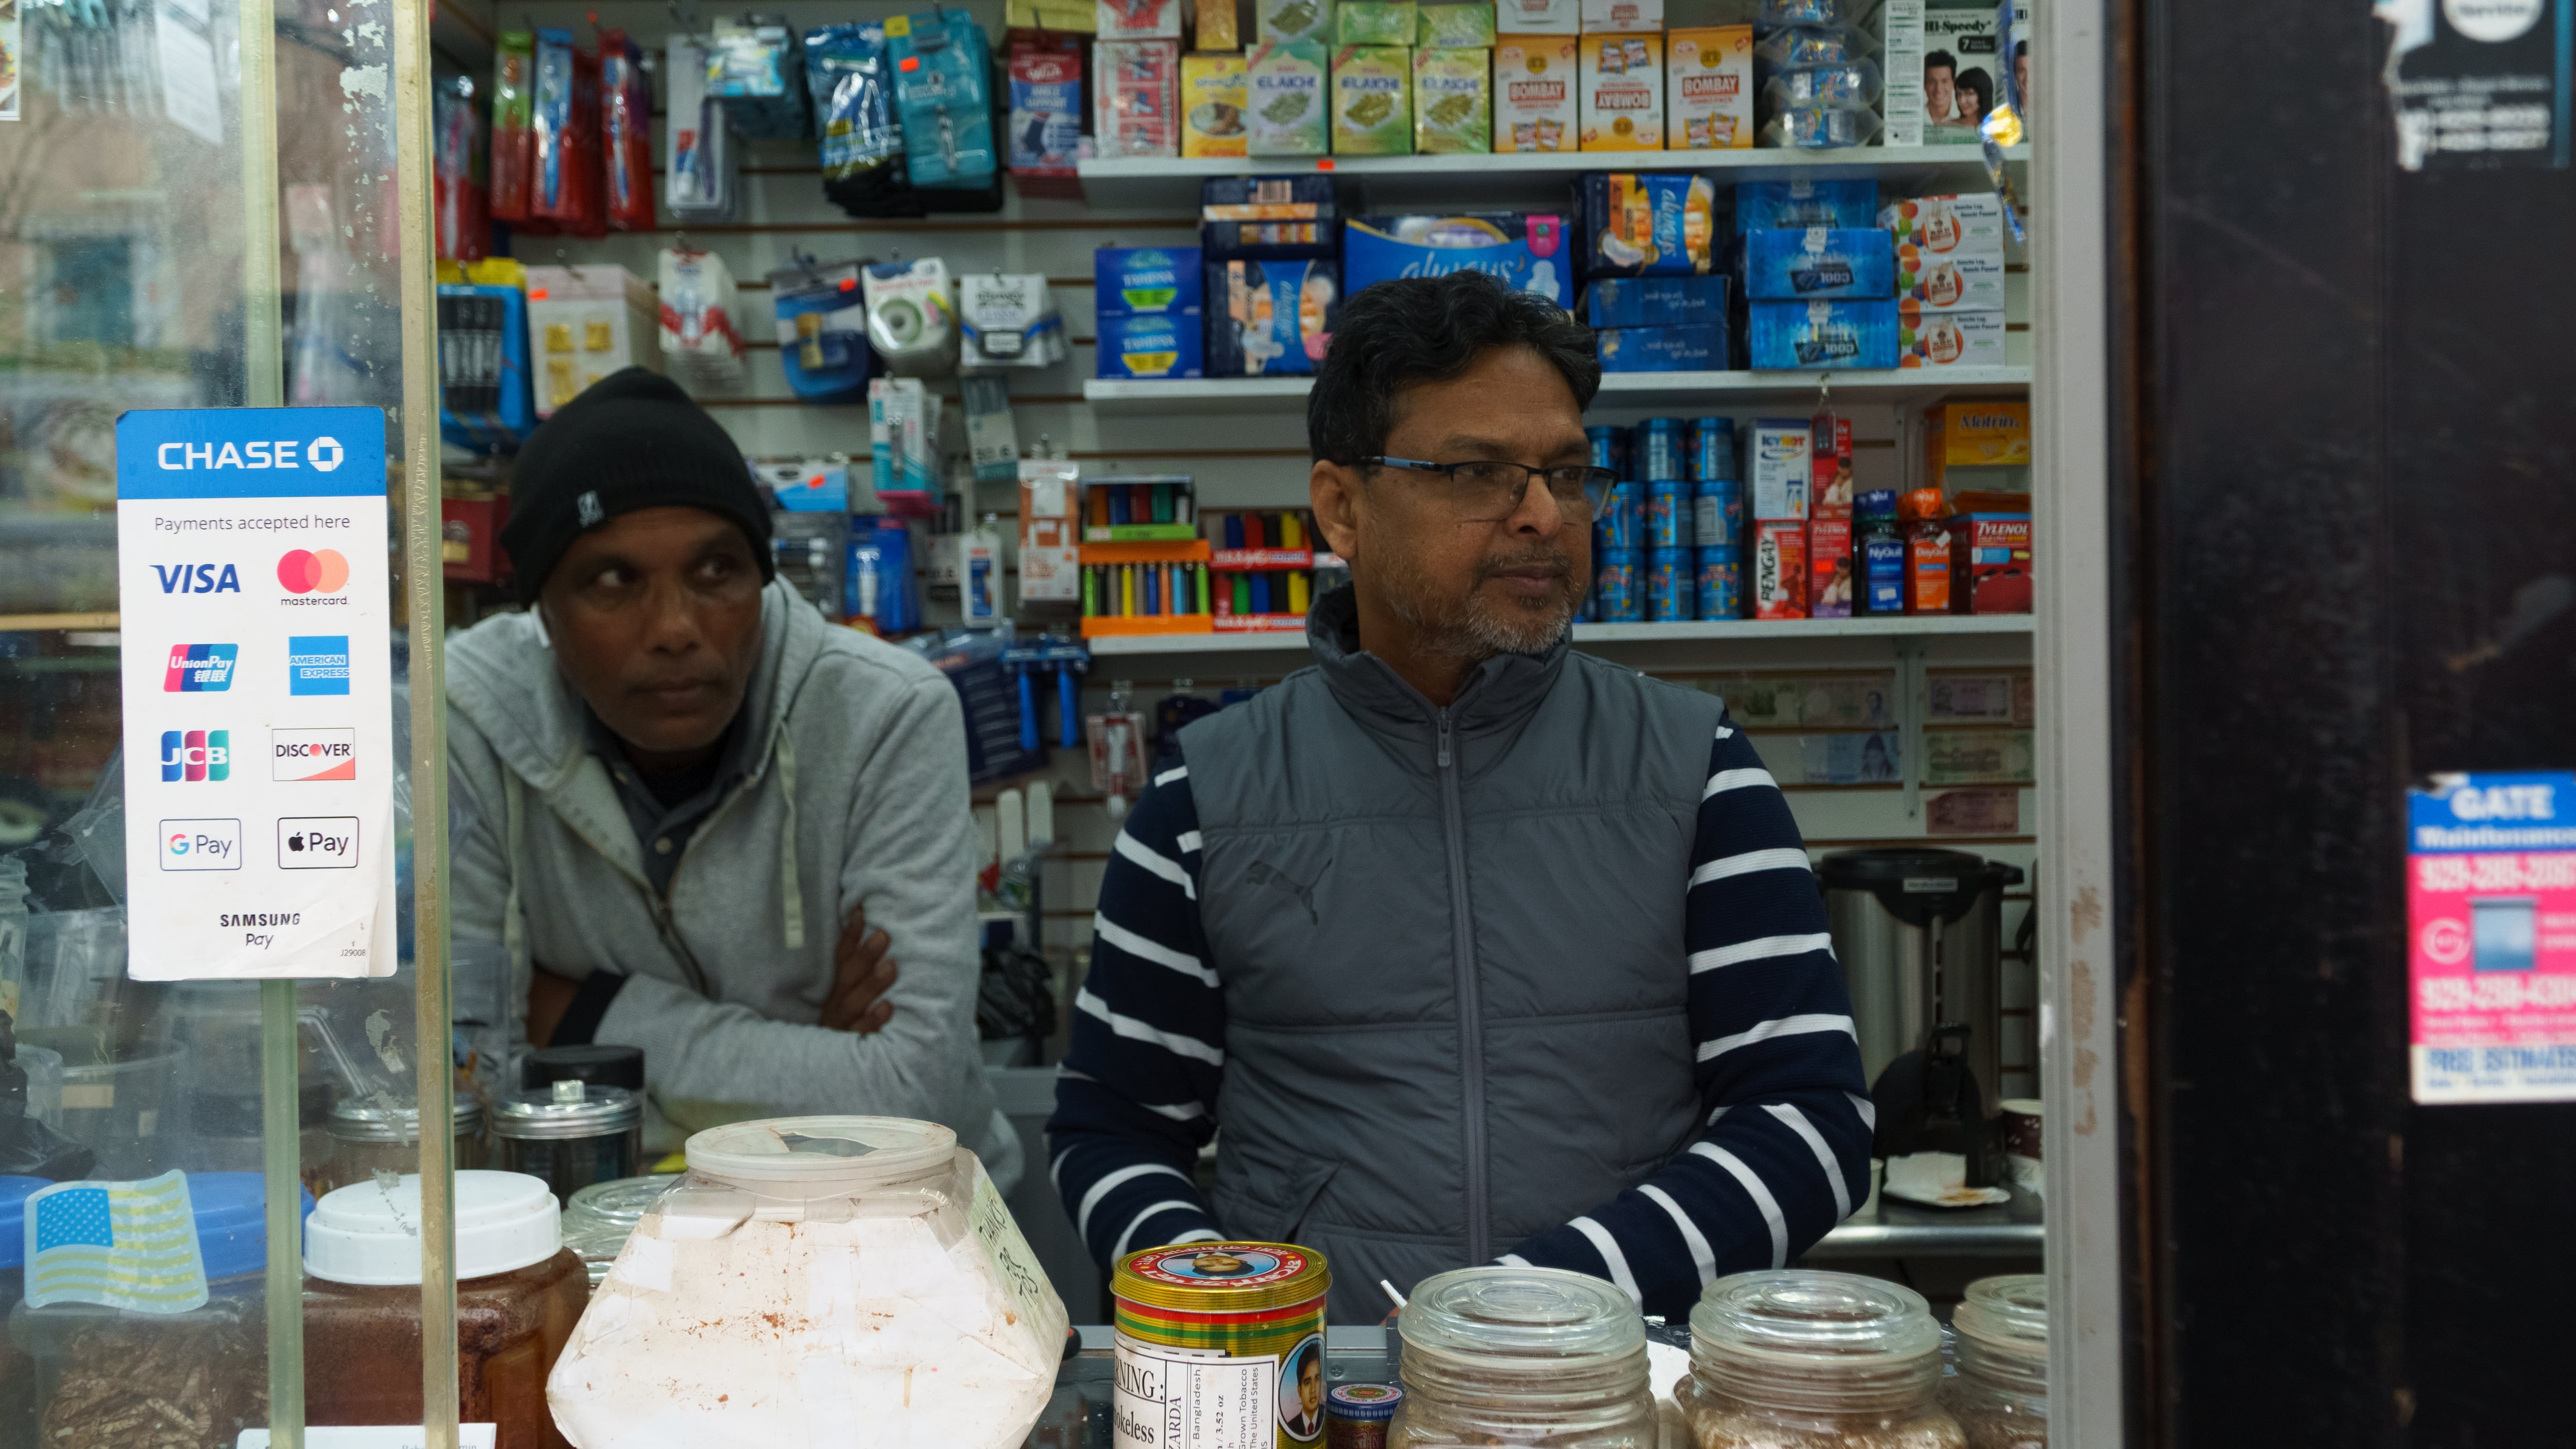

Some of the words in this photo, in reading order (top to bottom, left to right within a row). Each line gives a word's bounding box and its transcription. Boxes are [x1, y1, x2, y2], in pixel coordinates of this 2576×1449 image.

[1511, 83, 1564, 98] BOMBAY
[1684, 77, 1737, 93] BOMBAY
[1660, 189, 1683, 257] always
[1960, 414, 2014, 429] Motrin
[158, 441, 299, 470] CHASE
[155, 517, 233, 534] Payments
[238, 516, 309, 533] accepted
[314, 515, 350, 529] here
[1978, 522, 2028, 536] TYLENOL
[149, 564, 241, 593] VISA
[171, 656, 233, 672] UnionPay
[290, 655, 346, 666] AMERICAN
[194, 671, 227, 683] 银联
[301, 669, 349, 678] EXPRESS
[161, 747, 228, 765] JCB
[276, 744, 350, 757] DISCOVER
[2451, 784, 2556, 820] GATE
[170, 833, 190, 855] G
[196, 835, 232, 859] Pay
[310, 832, 349, 856] Pay
[220, 913, 300, 927] SAMSUNG
[246, 933, 274, 949] Pay
[979, 1197, 1007, 1252] THANKS
[1019, 1267, 1039, 1308] TIPS
[1239, 1369, 1247, 1412] Tobacco
[1193, 1369, 1202, 1440] Bangladesh
[1218, 1395, 1224, 1407] oz
